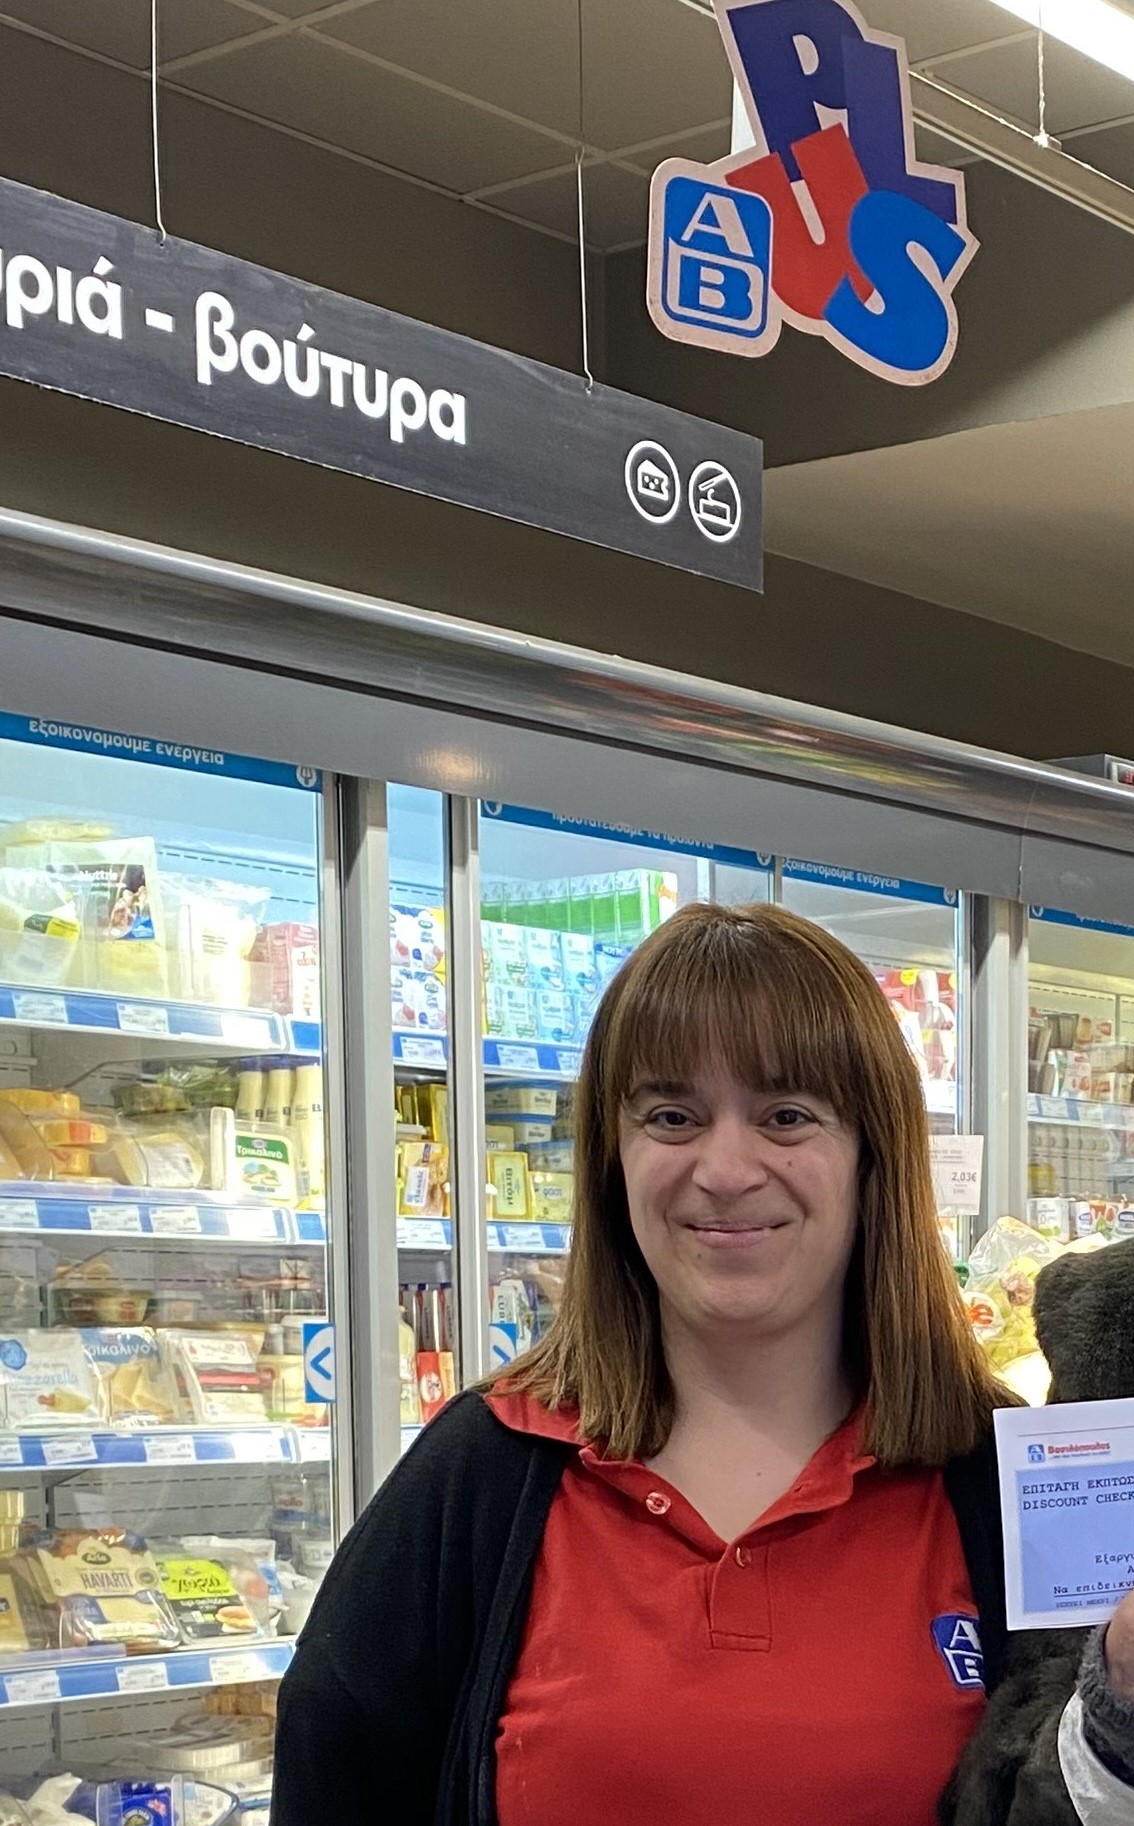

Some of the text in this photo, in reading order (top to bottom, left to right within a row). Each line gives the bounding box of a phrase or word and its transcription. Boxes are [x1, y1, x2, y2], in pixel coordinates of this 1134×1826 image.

[0, 255, 123, 340] ριά
[195, 291, 467, 445] βούτυρα
[29, 718, 225, 766] εξοικονομουμε ενεργεια
[856, 870, 900, 890] ενεργεια
[1022, 1481, 1080, 1494] ΕΠΙΤΑΓΗ
[1023, 1496, 1088, 1510] DISCOUNT
[1053, 1585, 1068, 1594] Να
